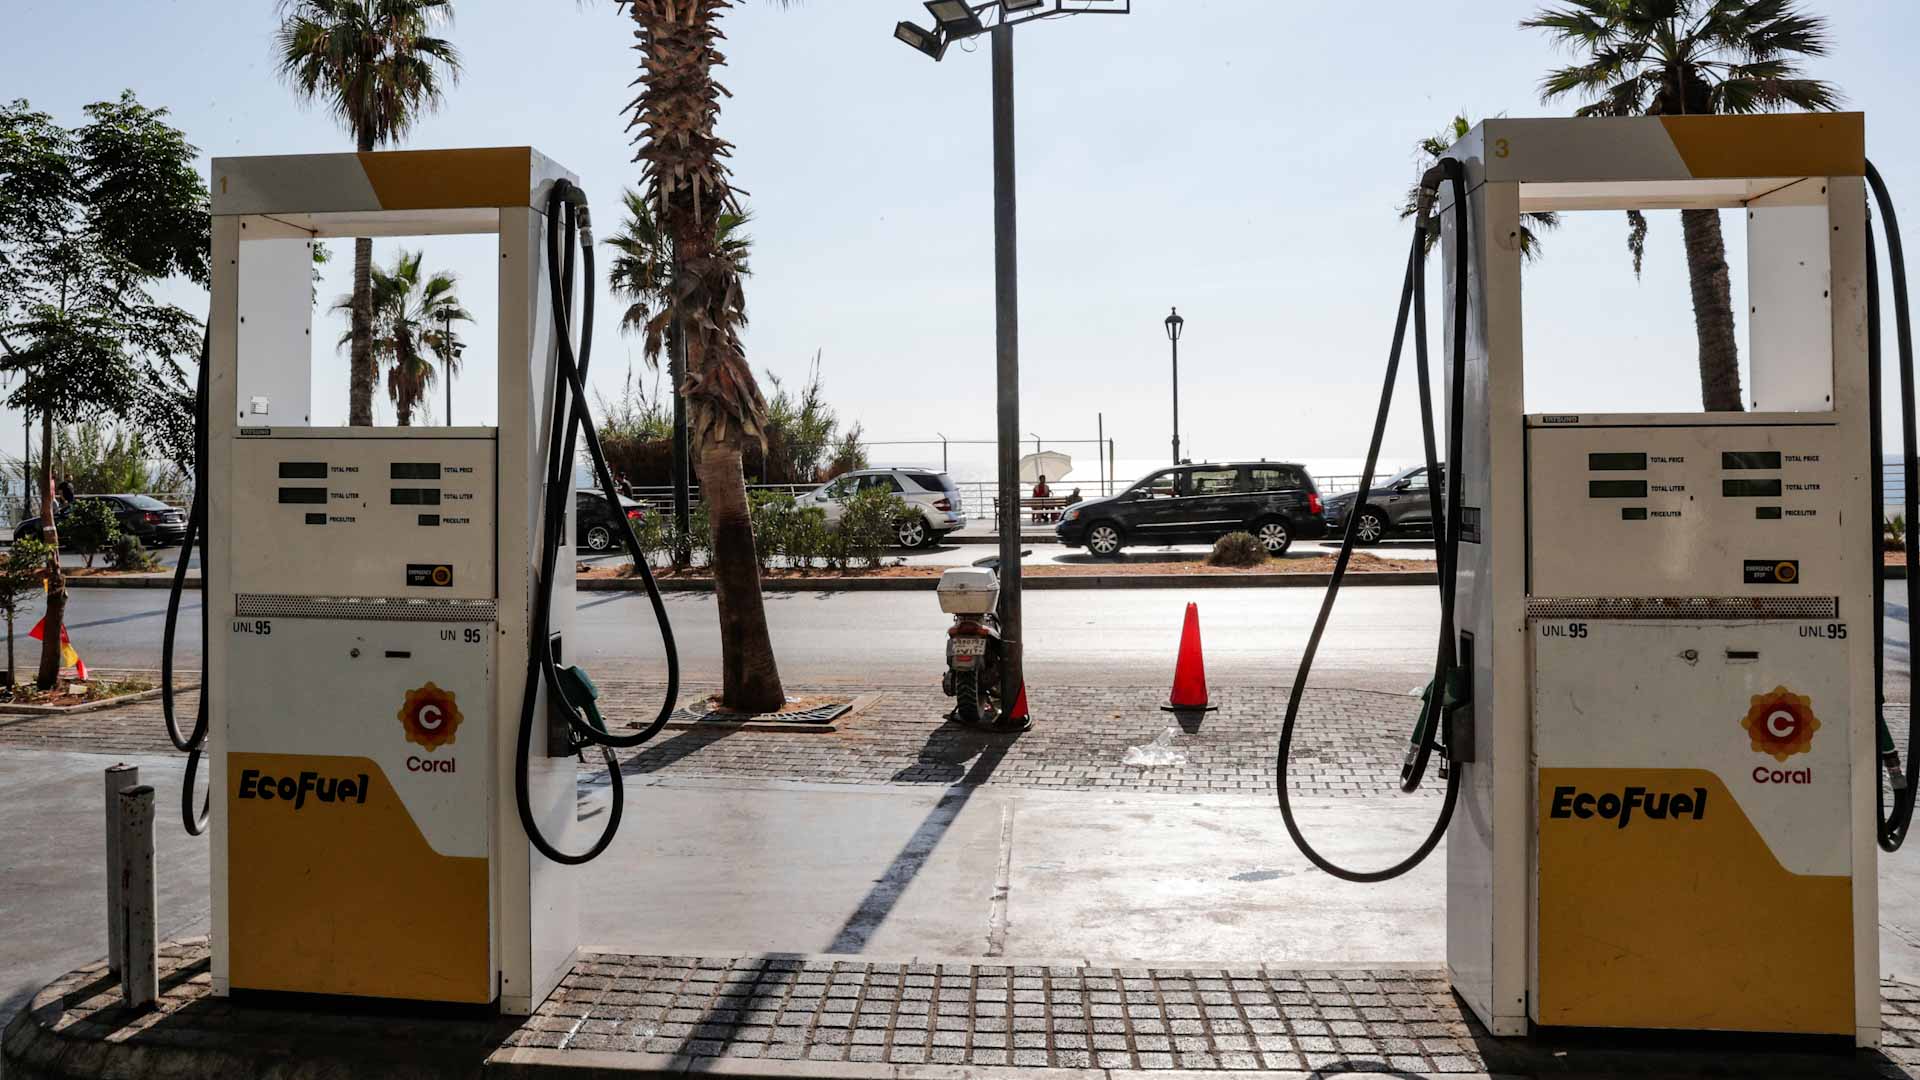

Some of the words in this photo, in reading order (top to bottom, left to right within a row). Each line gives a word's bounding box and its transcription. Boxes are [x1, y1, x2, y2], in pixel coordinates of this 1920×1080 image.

[1495, 138, 1509, 158] 3
[219, 175, 228, 194] 1
[232, 621, 254, 633] UNL
[255, 620, 271, 635] 95
[440, 629, 456, 641] UN
[463, 628, 481, 643] 95
[1542, 625, 1567, 637] UNL
[1569, 623, 1588, 638] 95
[1799, 625, 1826, 638] UNL
[1827, 623, 1847, 639] 95
[406, 755, 456, 773] Coral
[1752, 766, 1811, 785] Coral
[238, 769, 369, 810] EcoFuel
[1550, 786, 1708, 829] EcoFuel
